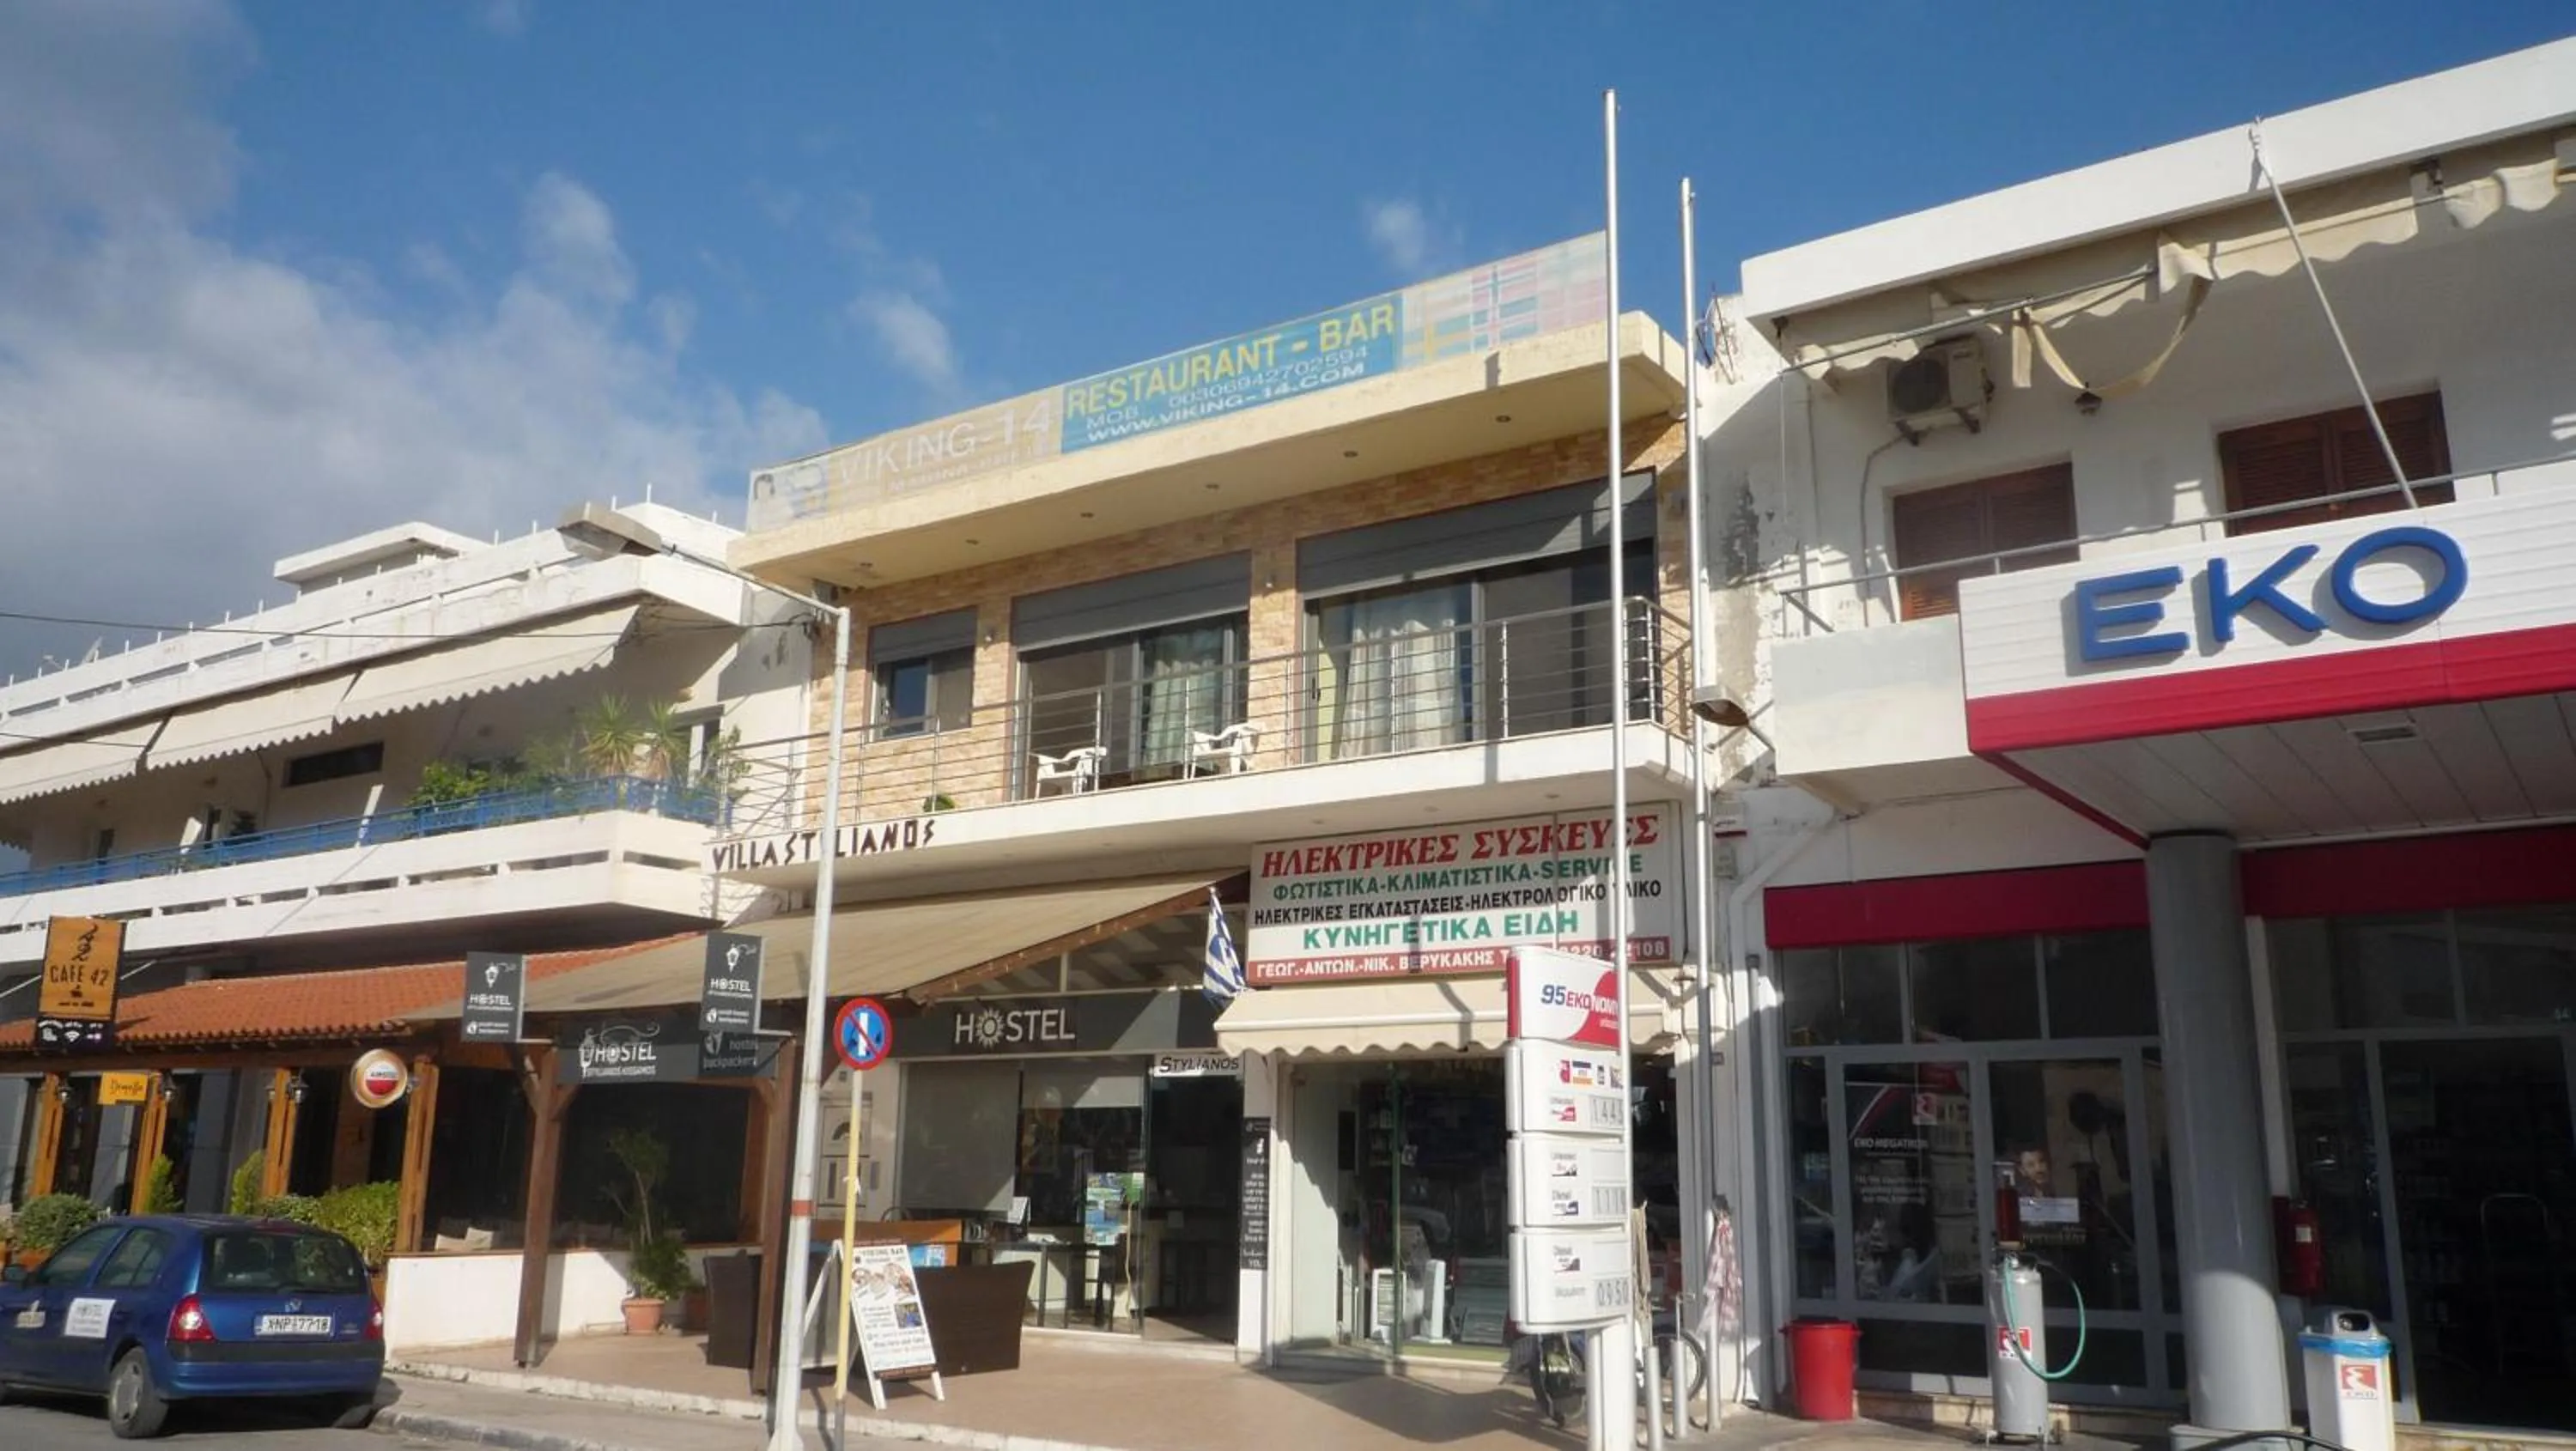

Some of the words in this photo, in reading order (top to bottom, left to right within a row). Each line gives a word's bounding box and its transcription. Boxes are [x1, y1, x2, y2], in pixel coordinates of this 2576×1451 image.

[1067, 334, 1281, 419] RESTAURANT
[1319, 304, 1394, 352] BAR
[2075, 525, 2468, 662] EKO
[713, 841, 778, 871] VILLA
[785, 819, 935, 865] STLIANOS
[1261, 833, 1460, 878] ΗΛΕΚΤΡΙΚΕΣ
[1255, 901, 1344, 926] ΗΛΕΚΤΡΙΚΕΣ
[1613, 879, 1662, 898] ΛΙΚΟ
[1303, 914, 1493, 950] ΚΥΝΗΓΕΤΙΚΑ
[1504, 909, 1578, 937] ΕΙΔΗ
[50, 965, 83, 983] CAFE
[90, 968, 110, 987] 42
[1399, 950, 1495, 971] ΒΕΡΥΚΑΚΗΣ
[1159, 1056, 1240, 1073] STYLIANOS
